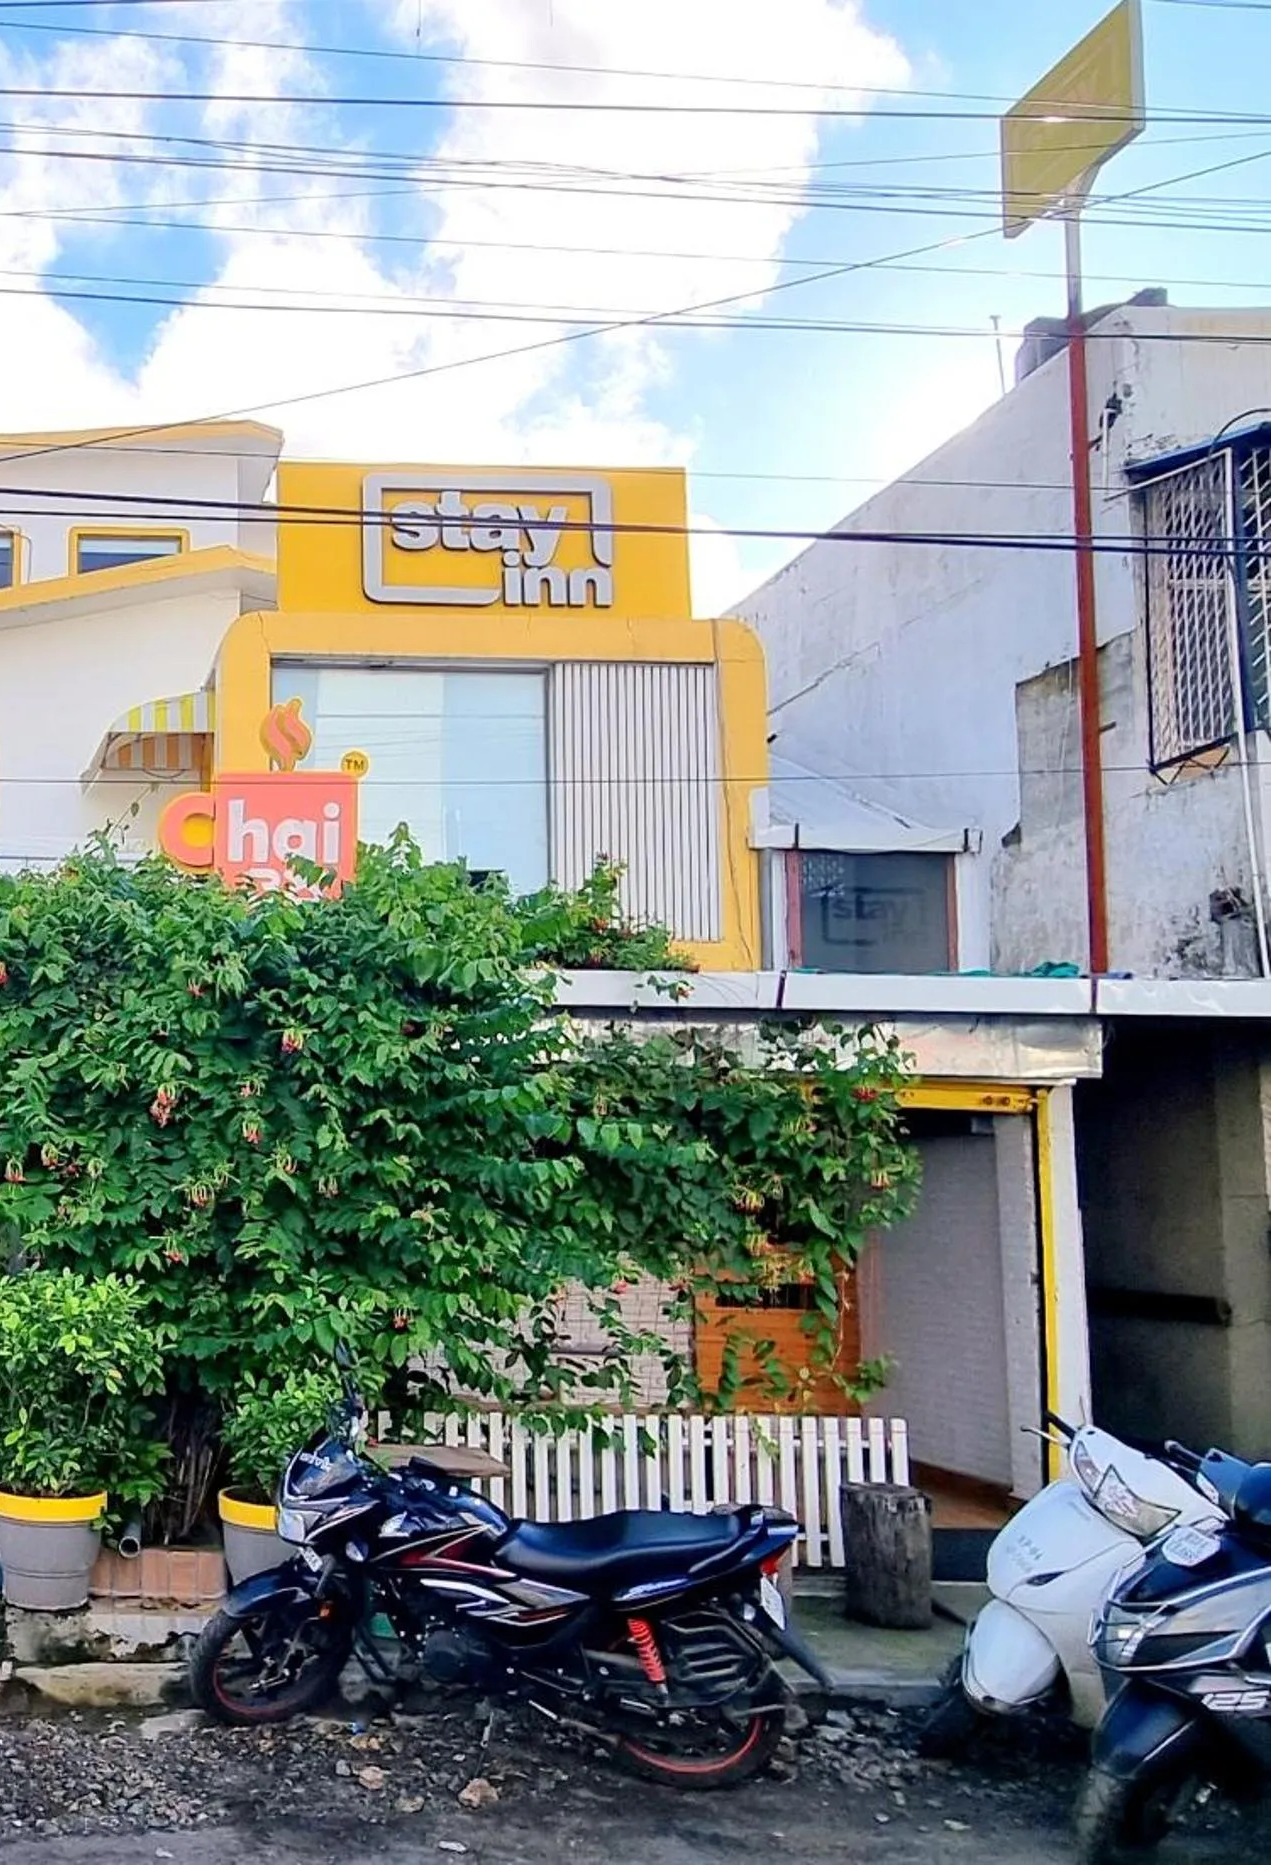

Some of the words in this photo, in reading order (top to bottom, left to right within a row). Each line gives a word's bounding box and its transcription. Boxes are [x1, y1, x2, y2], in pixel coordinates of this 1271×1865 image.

[391, 490, 567, 567] stay
[502, 550, 613, 607] inn
[345, 758, 365, 771] TM
